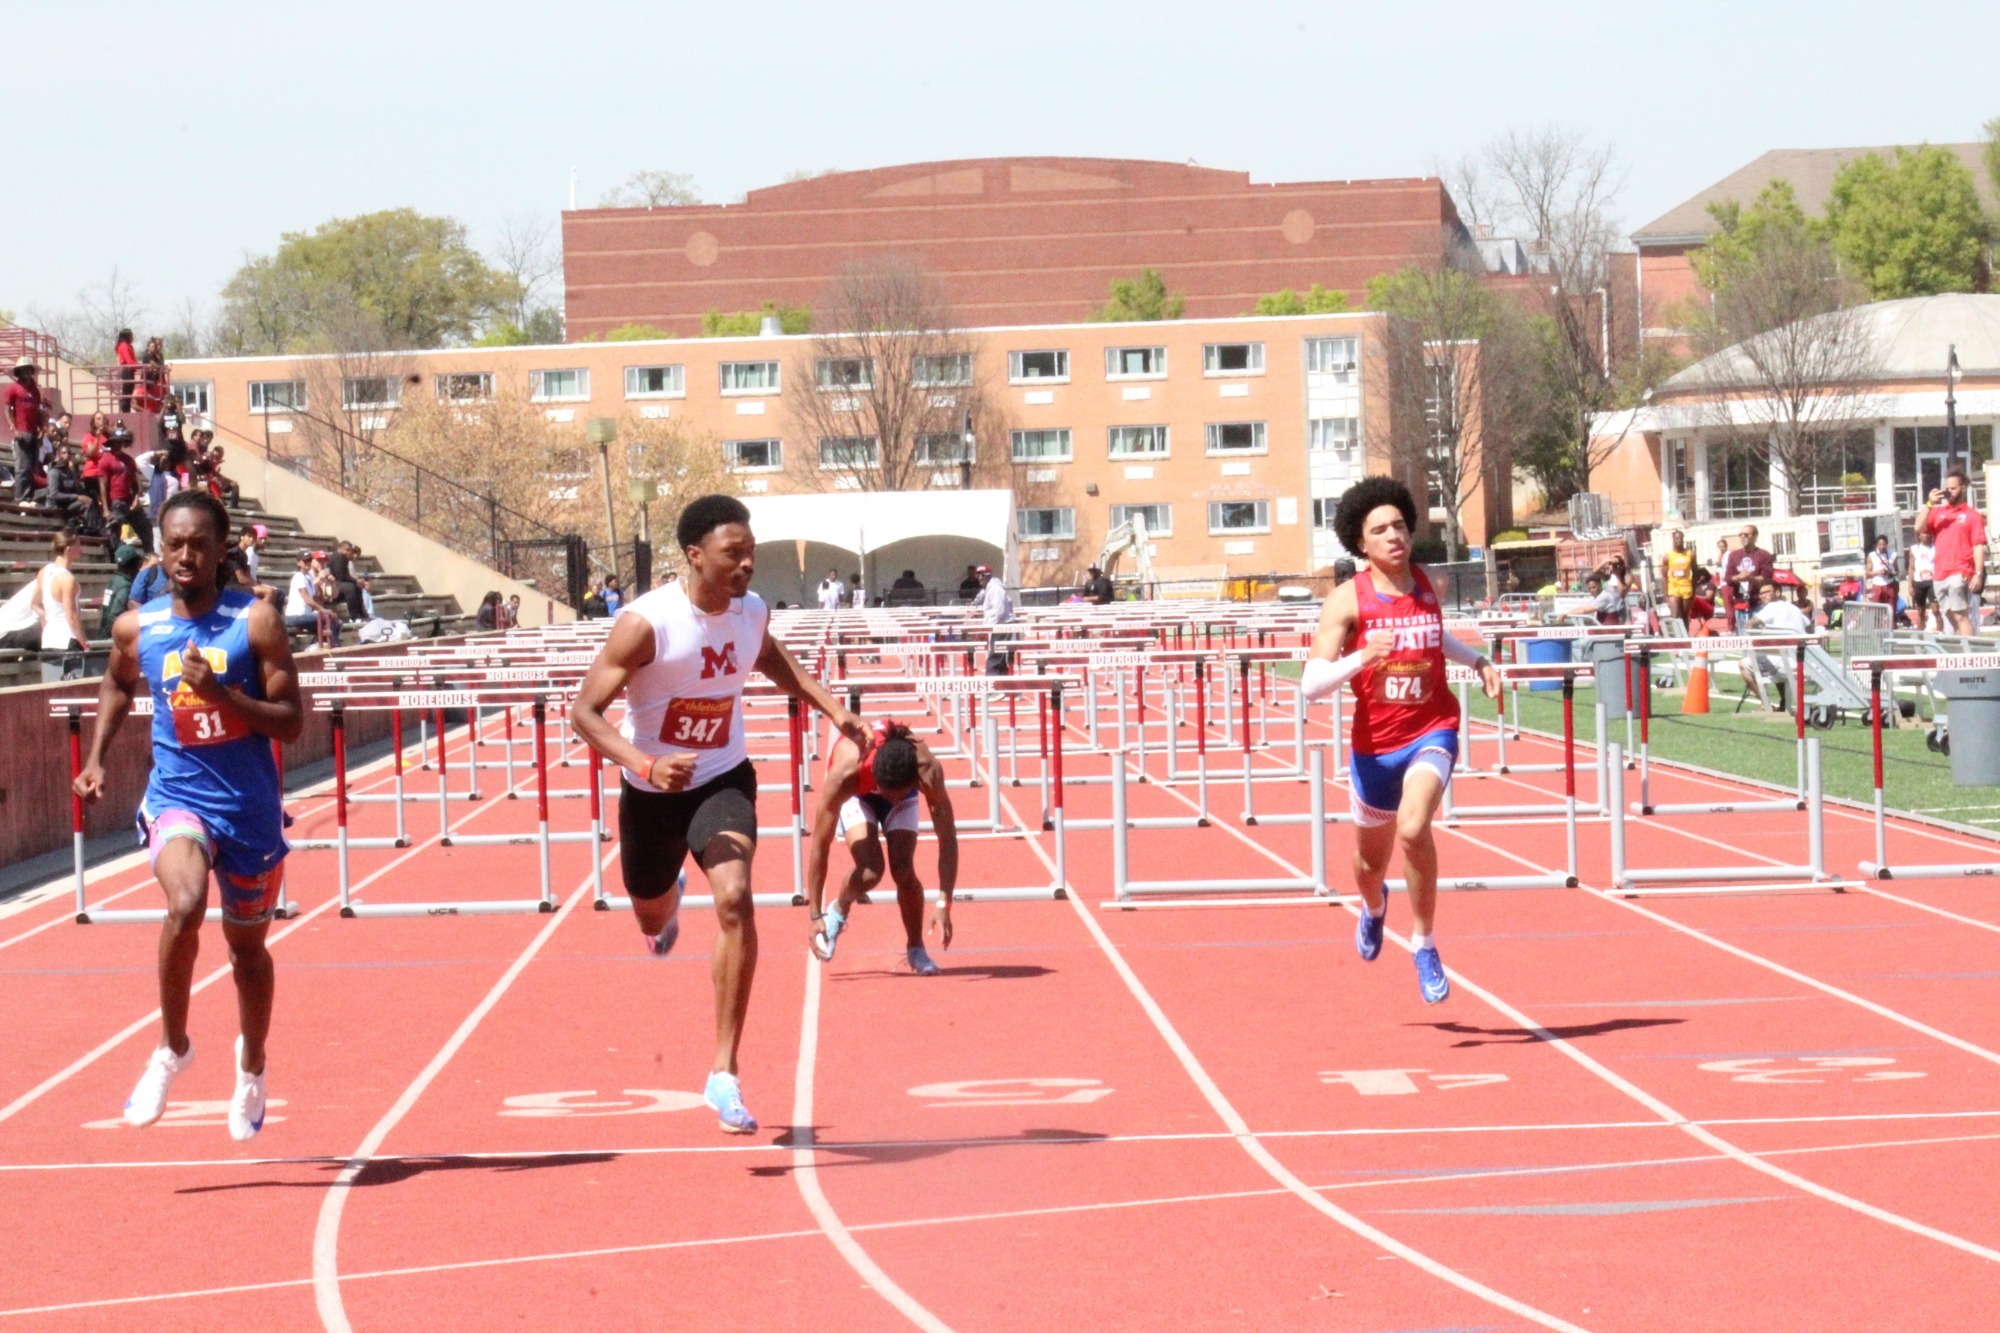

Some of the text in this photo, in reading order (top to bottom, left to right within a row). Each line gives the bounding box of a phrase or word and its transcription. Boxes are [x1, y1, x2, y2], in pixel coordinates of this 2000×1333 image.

[1538, 628, 1588, 638] MOREHOUSE
[1050, 641, 1100, 650] MOREHOUSE
[1692, 639, 1753, 649] MOREHOUSE
[379, 658, 431, 668] MOREHOUSE
[701, 642, 737, 679] M
[1089, 654, 1151, 664] MOREHOUSE
[1936, 656, 2000, 669] MOREHOU
[487, 670, 549, 681] MOREHOUSE
[916, 681, 995, 693] MOREHOUSE
[1385, 676, 1422, 700] 674
[401, 694, 478, 707] MOREHOUSE
[193, 711, 226, 739] 31
[675, 716, 723, 742] 347
[1964, 868, 1994, 876] UCS
[1455, 881, 1487, 890] UCS
[428, 907, 458, 915] UCS
[1697, 1056, 1929, 1084] 3
